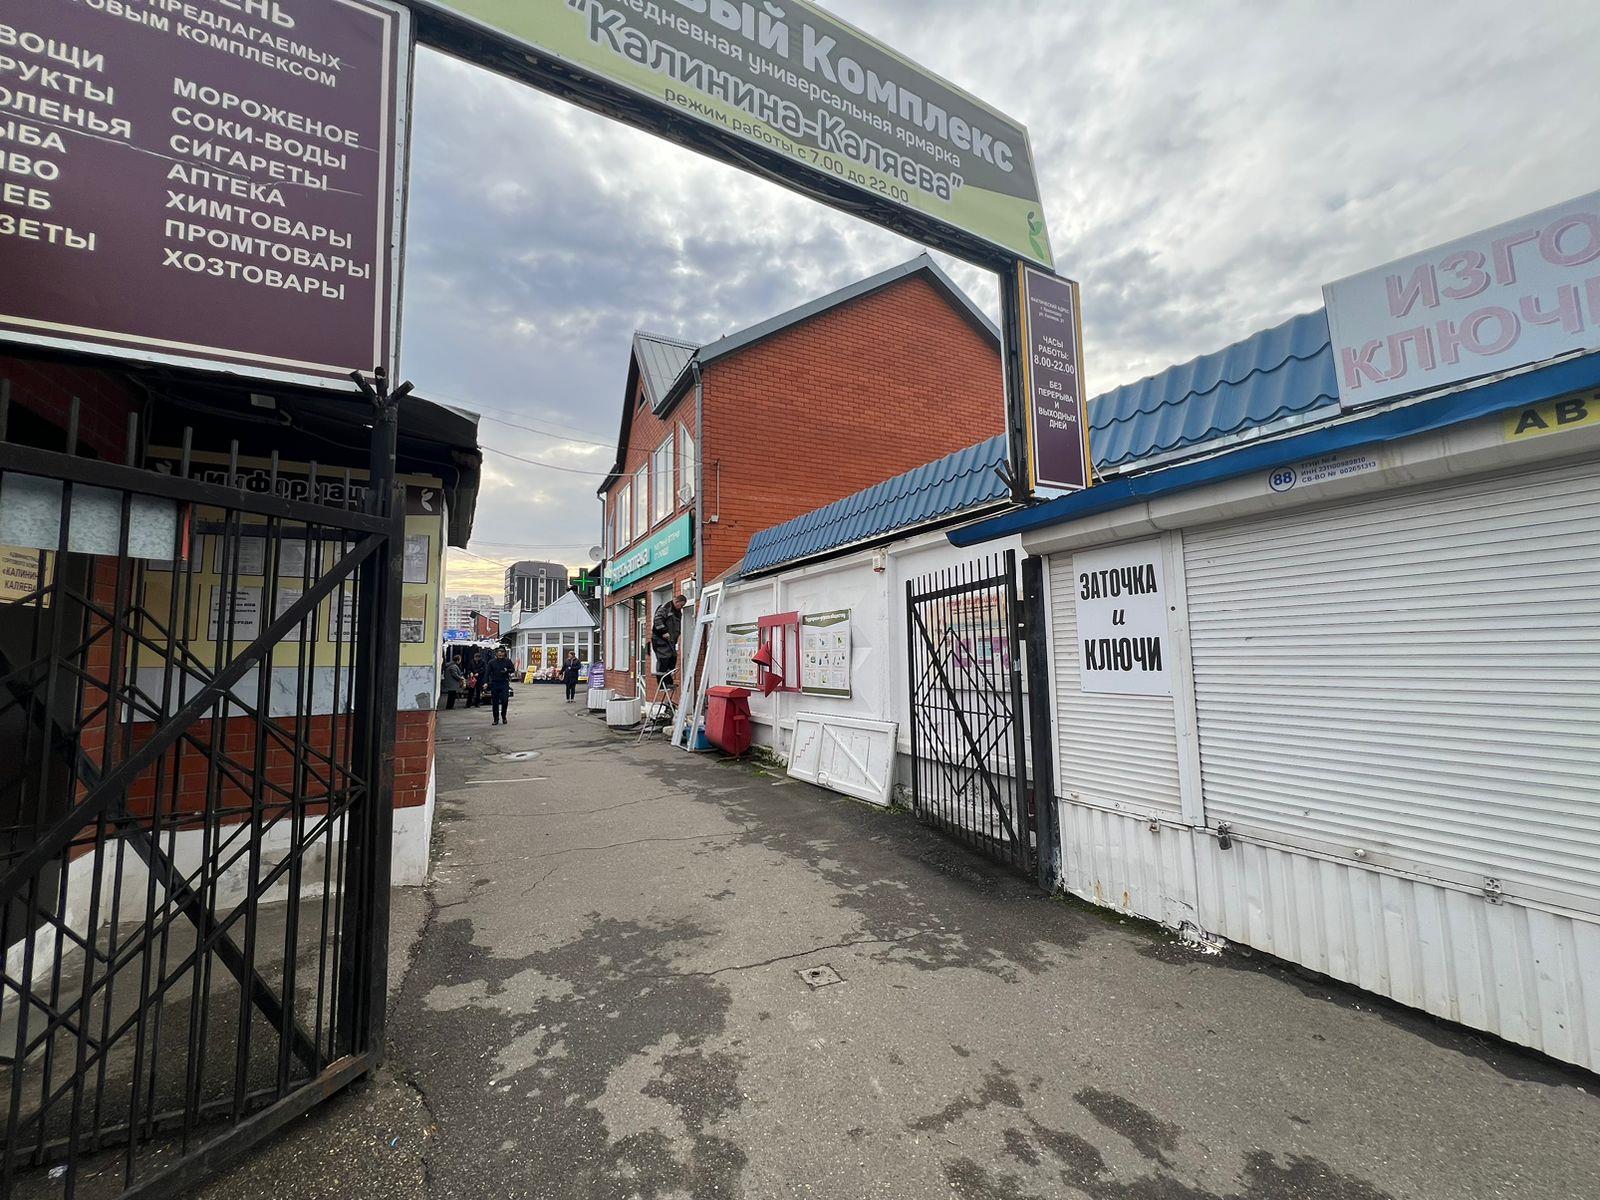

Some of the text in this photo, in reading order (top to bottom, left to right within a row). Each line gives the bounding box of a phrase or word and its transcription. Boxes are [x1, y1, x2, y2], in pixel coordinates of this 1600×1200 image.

[176, 22, 336, 88] КОМПЛЕКСОМ
[617, 0, 961, 168] едневная универсальная ярмарка
[802, 23, 1014, 173] Комплекс
[173, 77, 360, 148] МОРОЖЕНОЕ
[171, 106, 347, 170] СОКИ-ВОДЫ
[665, 88, 909, 203] режим работы с 7.00 до 22.00
[0, 150, 59, 181] ВО
[170, 134, 328, 191] СИГАРЕТЫ
[167, 164, 287, 207] АПТЕКА
[165, 190, 352, 250] ХИМТОВАРЫ
[165, 219, 370, 280] ПРОМТОВАРЫ
[162, 247, 345, 300] ХОЗТОВАРЫ
[1038, 344, 1069, 360] РАБОТЫ:
[1043, 335, 1064, 349] ЧАСЫ
[1033, 354, 1075, 375] 8.00-22.00
[1038, 387, 1074, 404] ПЕРЕРЫВА
[1049, 380, 1062, 391] БЕЗ
[1038, 406, 1077, 423] ВЫХОДНЫХ
[1054, 401, 1060, 410] И
[1049, 419, 1068, 431] ДНЕЙ
[1273, 471, 1293, 486] 88
[1301, 468, 1317, 477] ИНН
[1301, 473, 1326, 483] СВ-ВО
[1080, 563, 1158, 600] ЗАТОЧКА
[1112, 609, 1126, 625] и
[1084, 637, 1163, 671] КЛЮЧИ
